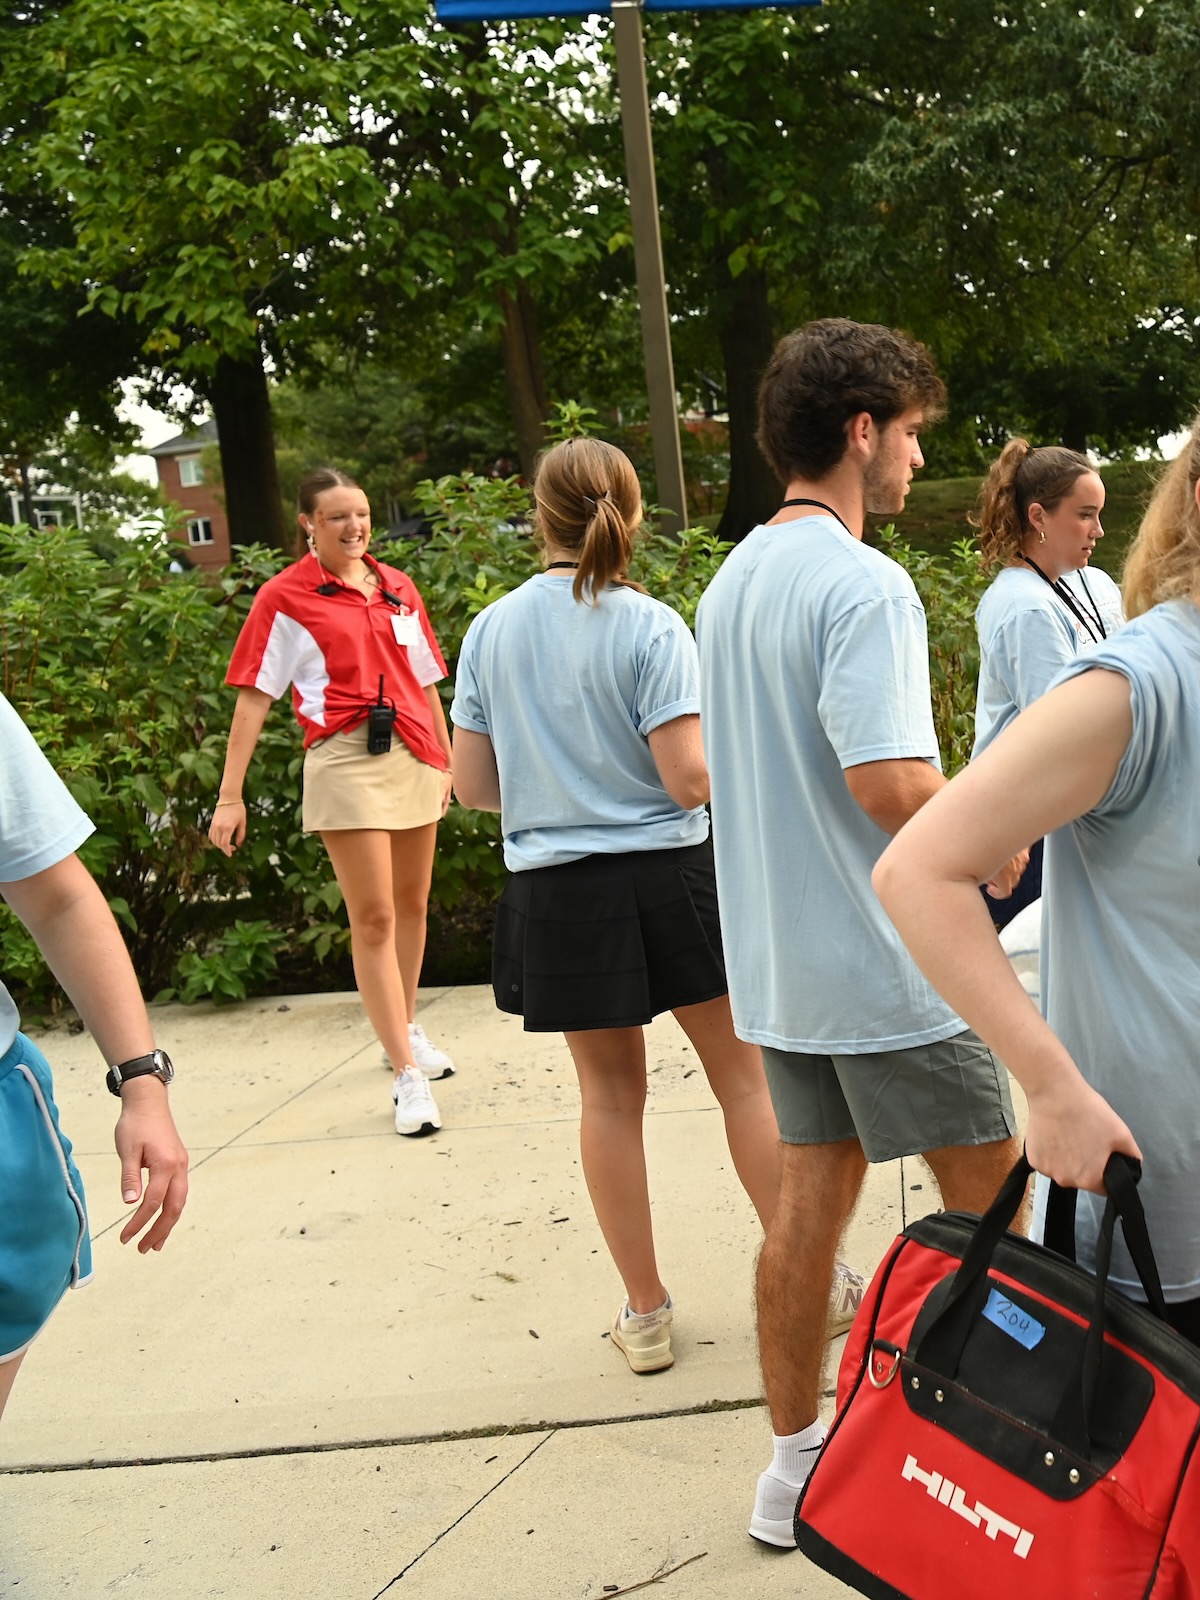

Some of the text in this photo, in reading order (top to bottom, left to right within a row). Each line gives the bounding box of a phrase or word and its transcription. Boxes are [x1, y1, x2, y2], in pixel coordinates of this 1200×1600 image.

[840, 1288, 862, 1313] N
[996, 1300, 1030, 1334] 204
[901, 1453, 1035, 1560] HILTI
